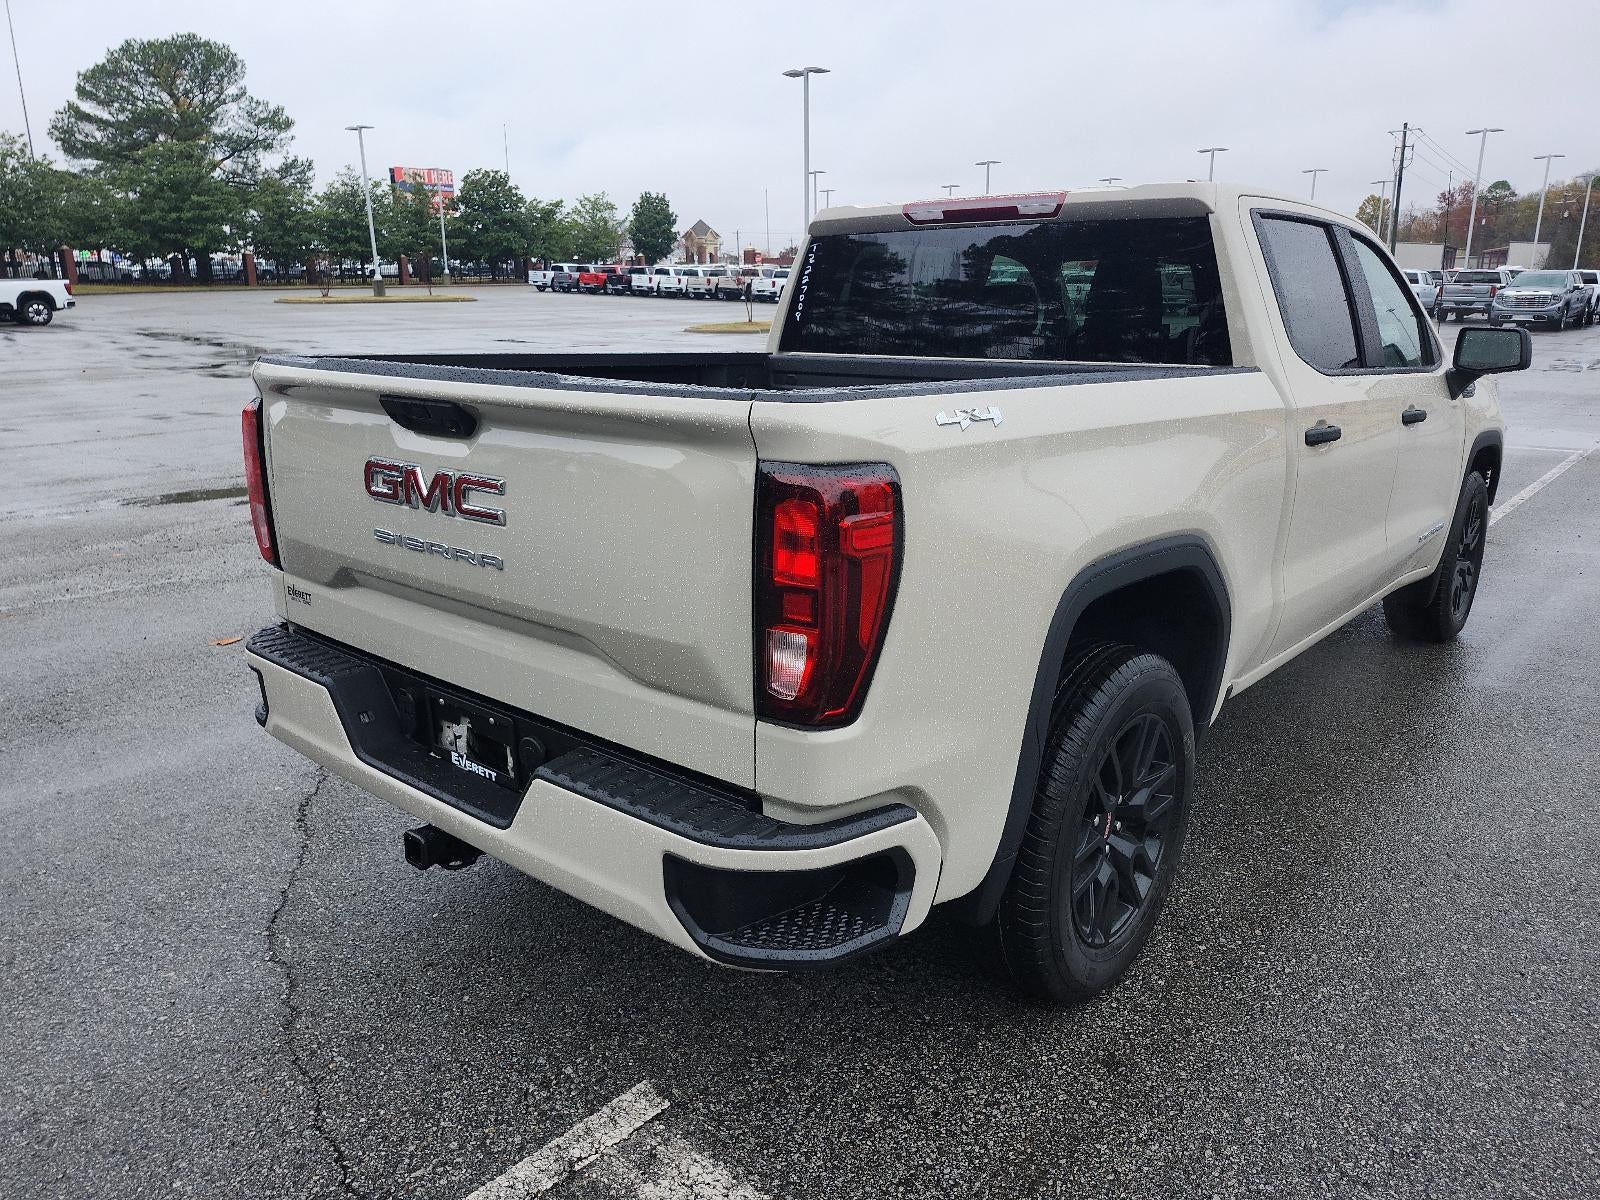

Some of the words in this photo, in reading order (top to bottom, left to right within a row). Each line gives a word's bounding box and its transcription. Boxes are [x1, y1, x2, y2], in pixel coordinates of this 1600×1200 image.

[364, 455, 506, 526] GMC
[373, 527, 504, 570] SIERRA
[451, 751, 497, 781] EVERETT
